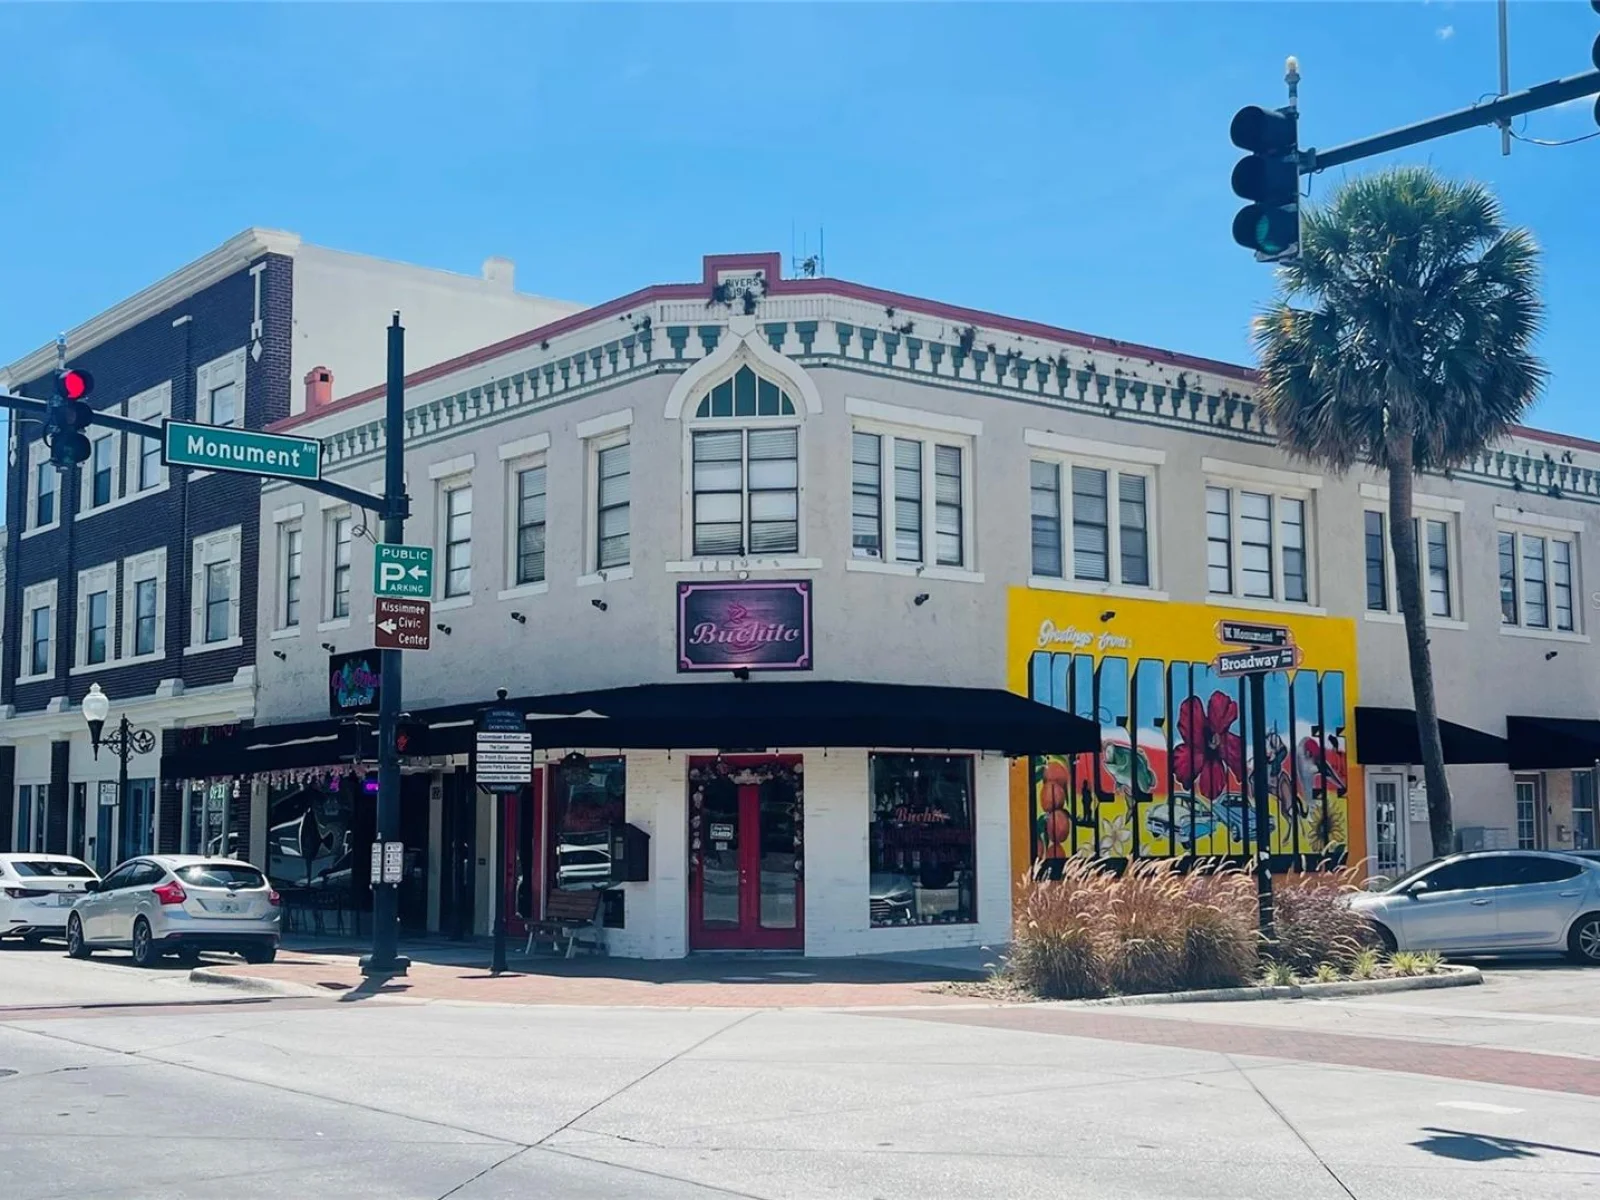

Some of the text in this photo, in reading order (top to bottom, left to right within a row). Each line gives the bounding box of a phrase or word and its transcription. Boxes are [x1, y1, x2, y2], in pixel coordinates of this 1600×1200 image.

[725, 278, 759, 287] RIVERS
[187, 435, 300, 468] Monument
[302, 443, 316, 455] Ave
[382, 548, 428, 560] PUBLIC
[381, 601, 425, 615] Kissimmee
[398, 617, 421, 629] Civic
[398, 633, 428, 646] Center
[689, 621, 800, 645] Buchito
[1038, 619, 1093, 648] Greetings
[1221, 655, 1279, 671] Broadway
